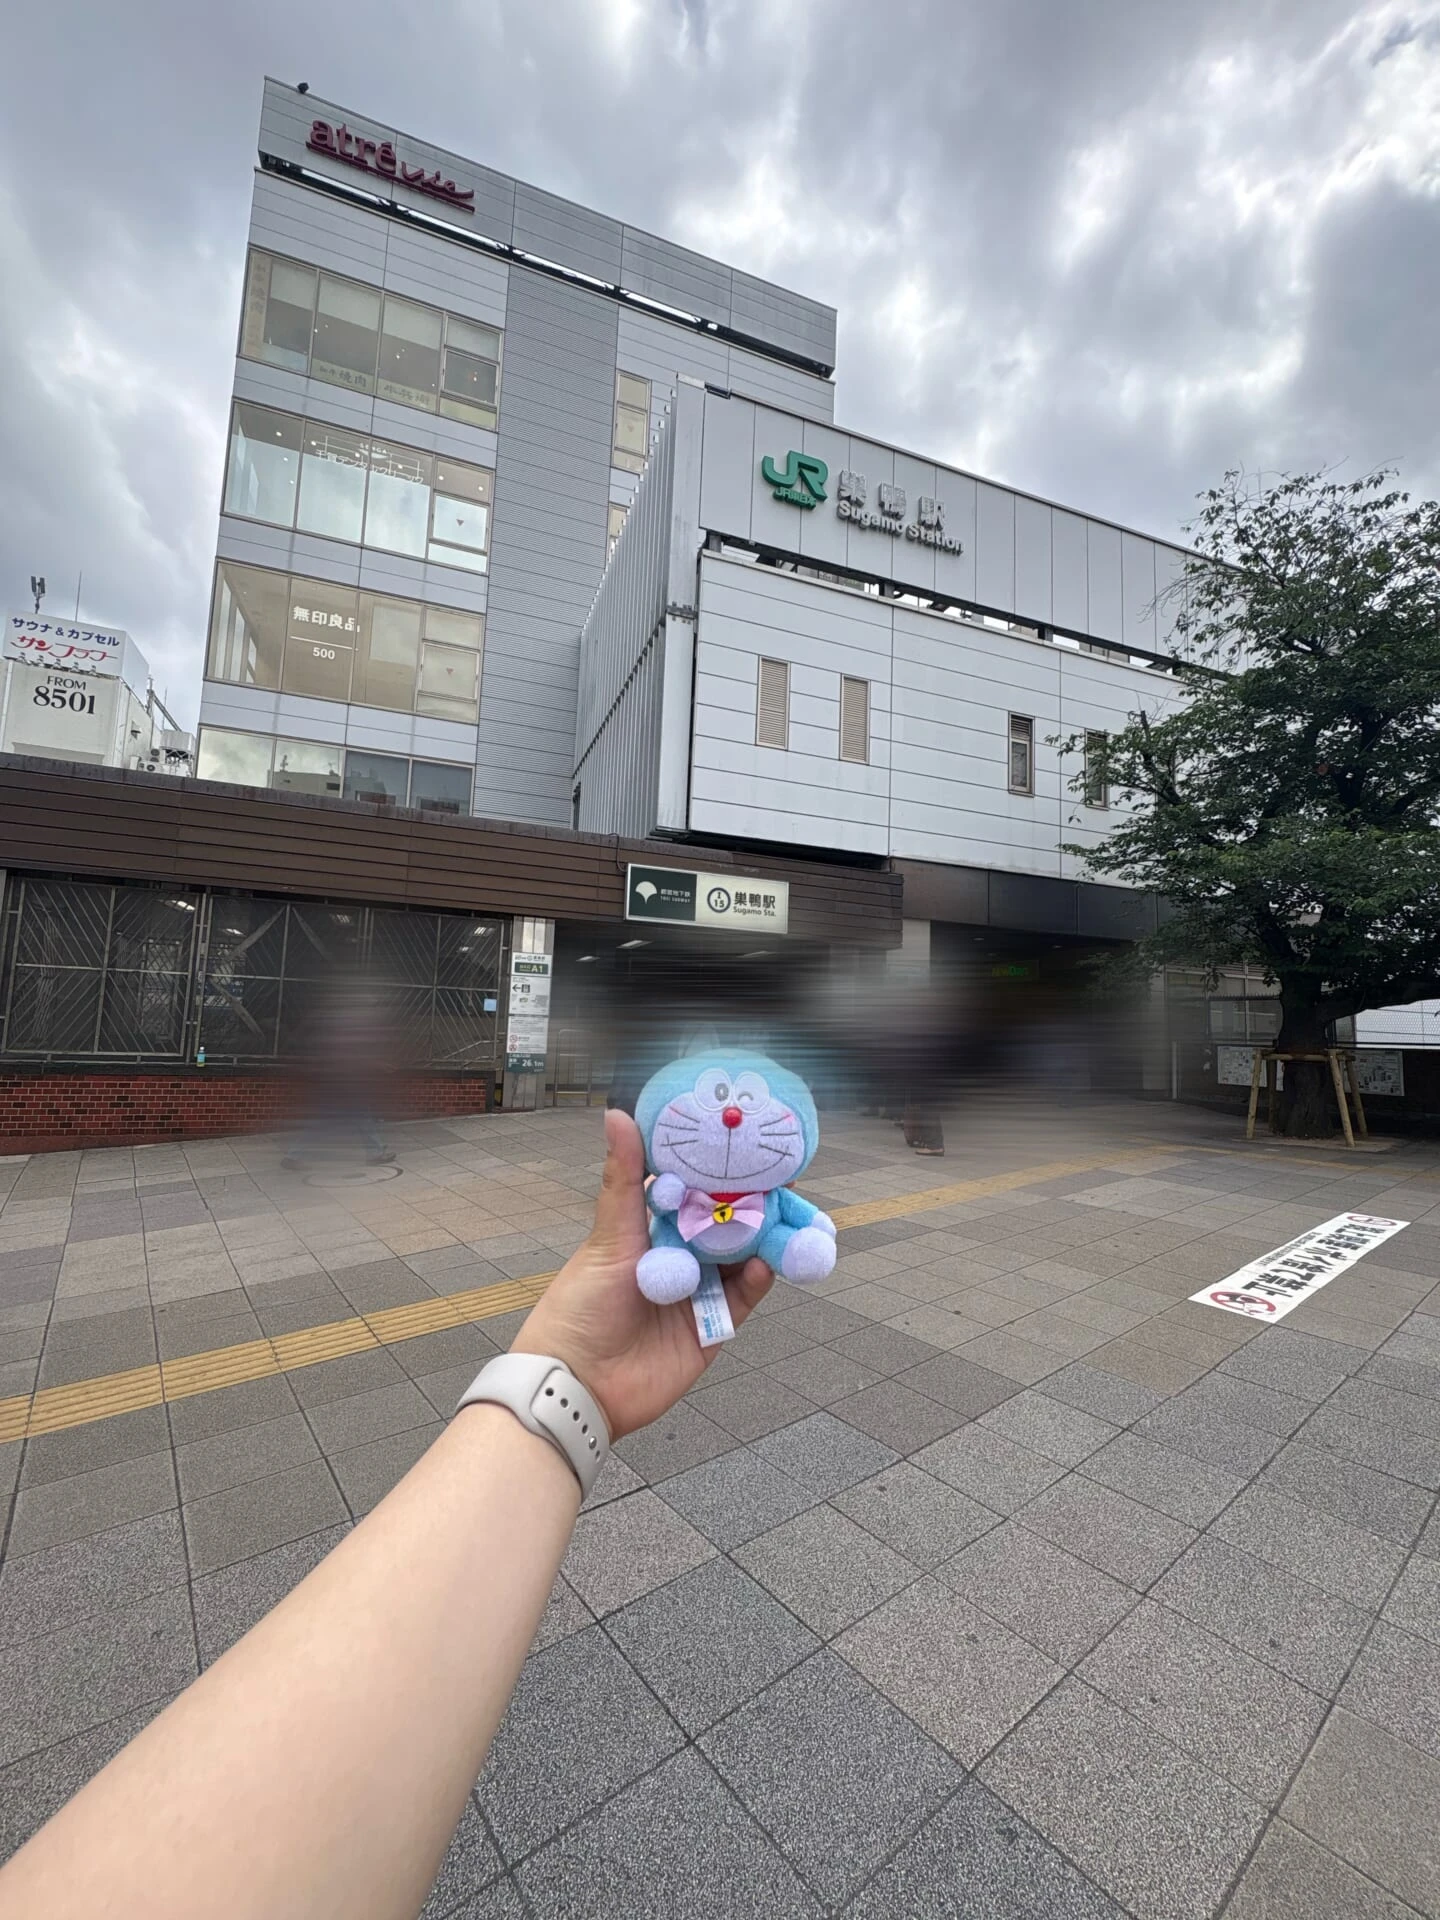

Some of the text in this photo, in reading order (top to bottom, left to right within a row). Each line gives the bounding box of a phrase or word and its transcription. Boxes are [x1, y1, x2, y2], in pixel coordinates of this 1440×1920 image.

[401, 161, 474, 200] vie
[761, 450, 829, 502] JR
[837, 469, 949, 532] 巣鴨駅
[837, 499, 966, 556] Sugamo Station
[293, 606, 360, 631] 無印良品
[312, 646, 336, 661] 500
[47, 675, 87, 690] FROM
[33, 685, 96, 715] 8501
[714, 899, 725, 908] 15
[734, 891, 776, 909] 巣鴨駅
[733, 906, 777, 917] Sugamo Sta.
[531, 964, 544, 973] A1
